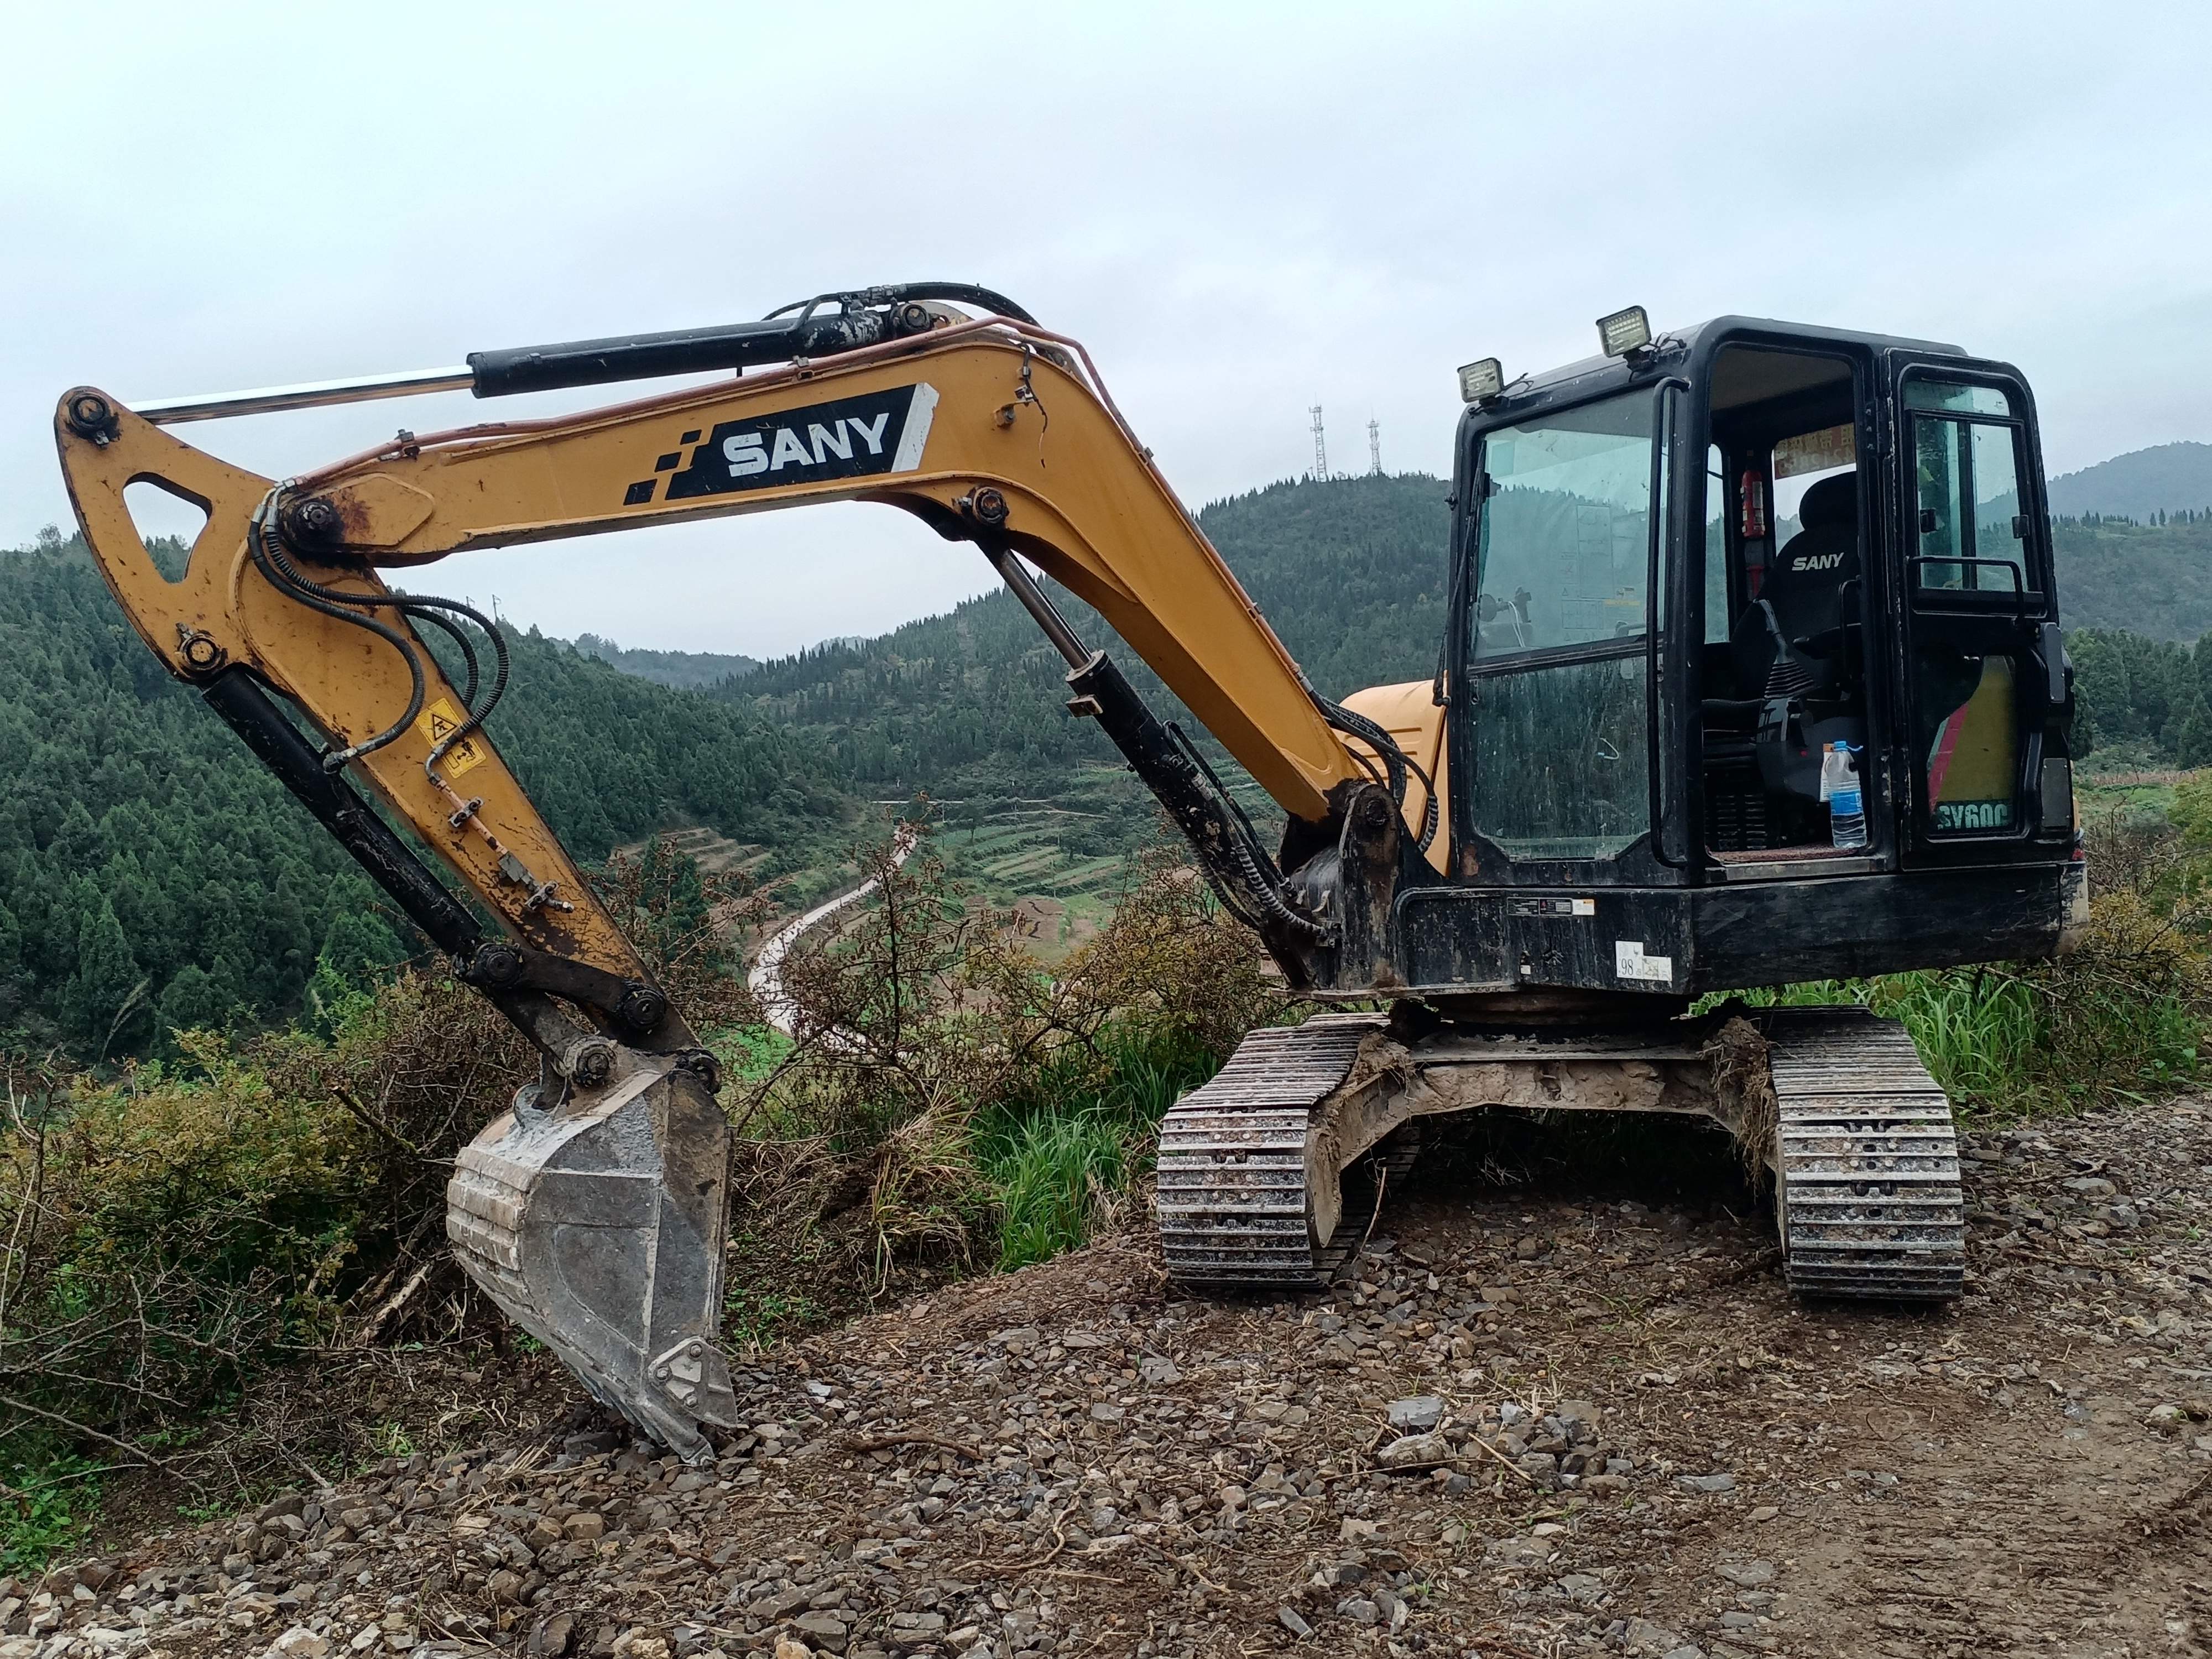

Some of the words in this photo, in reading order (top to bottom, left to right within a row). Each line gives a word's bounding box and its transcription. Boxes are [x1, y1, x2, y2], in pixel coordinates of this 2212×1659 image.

[723, 413, 889, 477] SANY
[1791, 552, 1844, 571] SANY
[1621, 958, 1634, 975] 98
